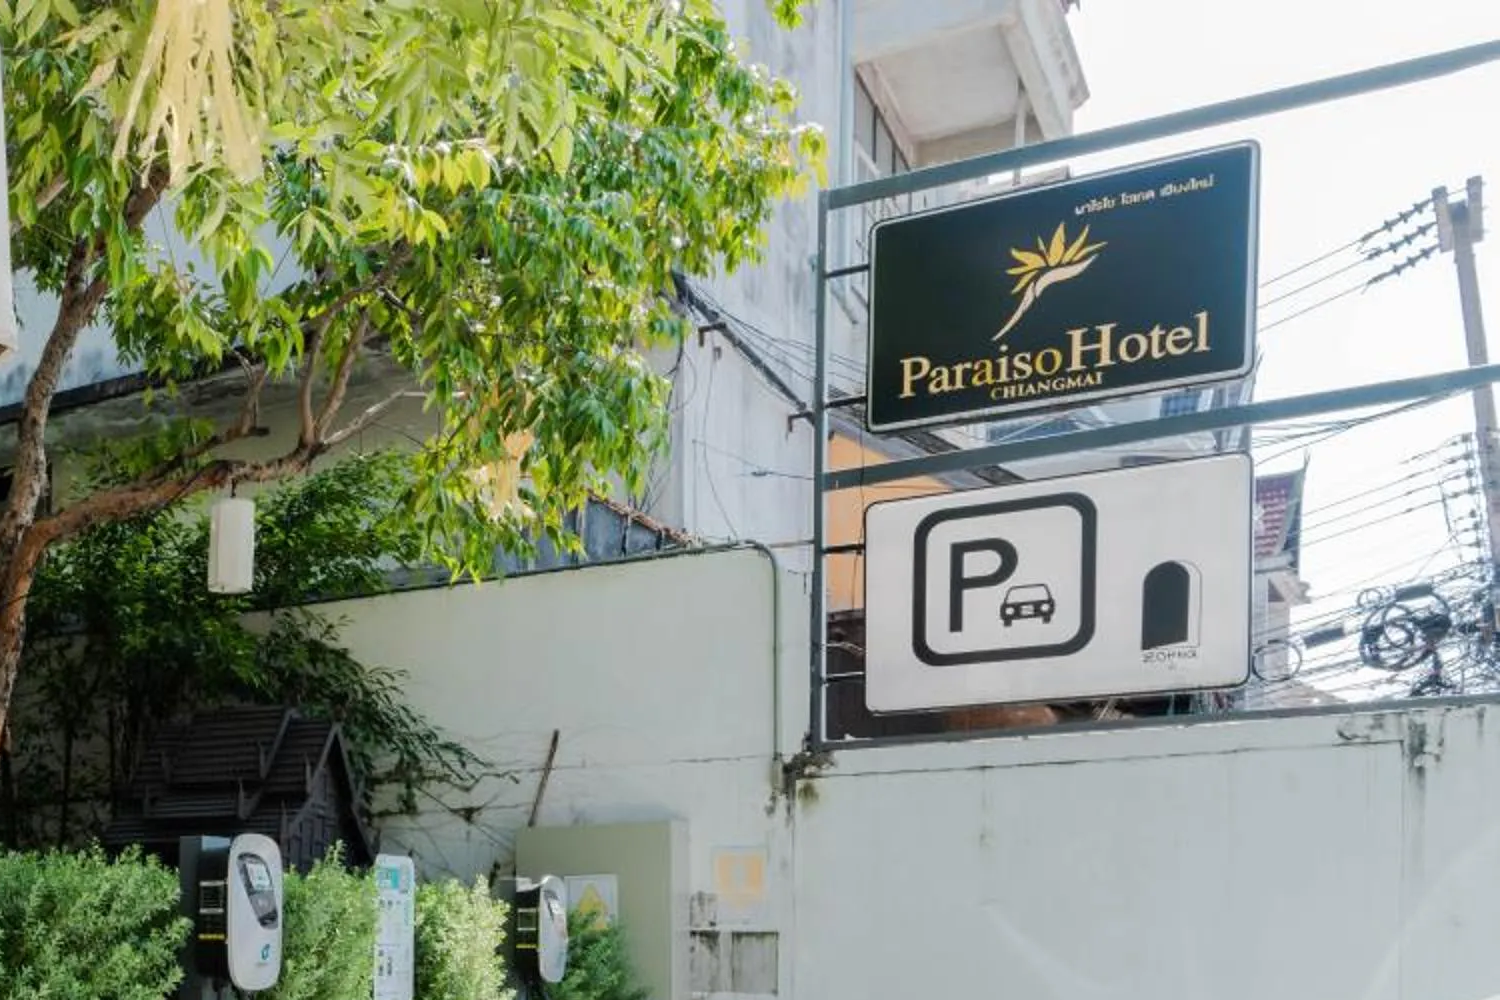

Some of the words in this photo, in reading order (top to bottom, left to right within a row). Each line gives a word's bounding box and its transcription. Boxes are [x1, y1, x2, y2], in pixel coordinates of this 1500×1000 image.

[897, 343, 1063, 399] Paraiso
[1065, 309, 1212, 372] Hotel
[990, 371, 1105, 401] CHIANGMAI
[949, 537, 1019, 633] P
